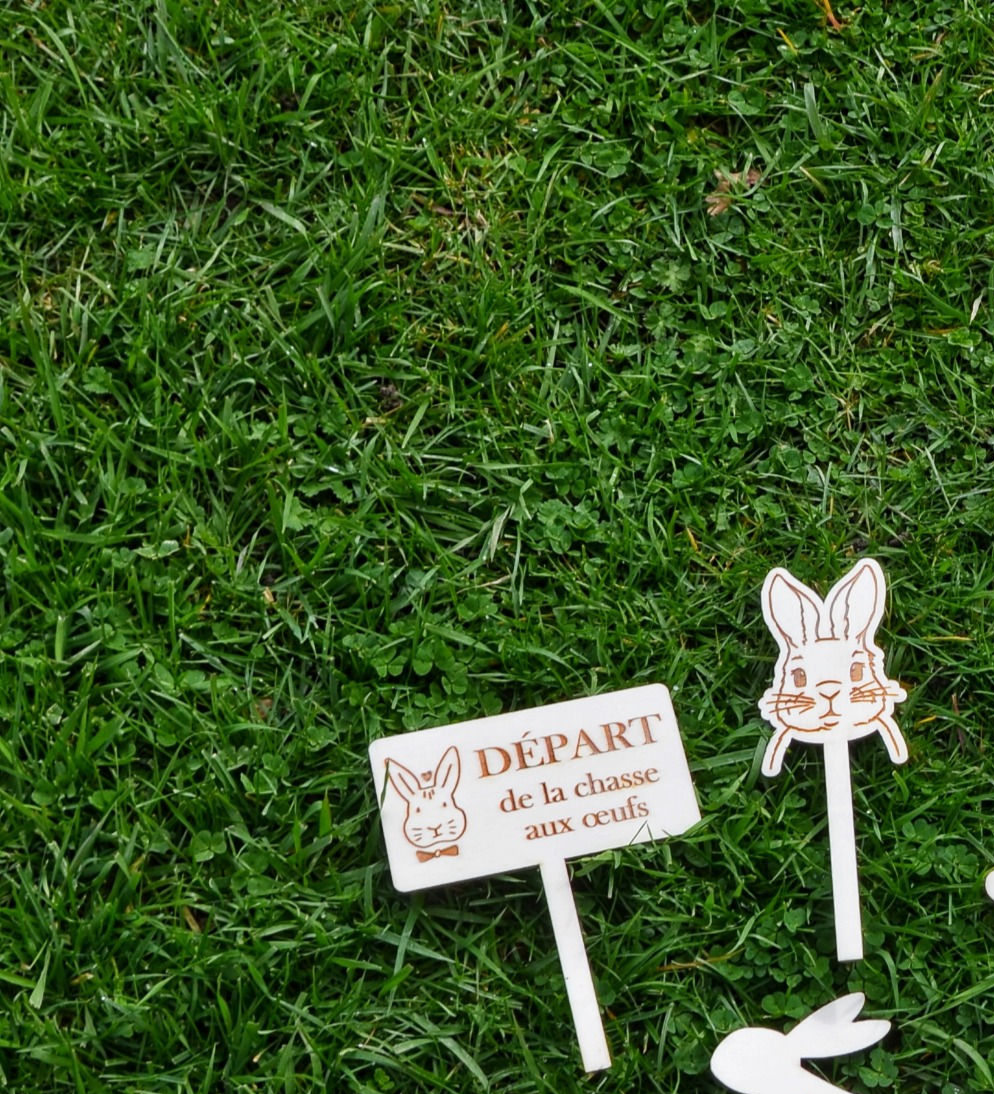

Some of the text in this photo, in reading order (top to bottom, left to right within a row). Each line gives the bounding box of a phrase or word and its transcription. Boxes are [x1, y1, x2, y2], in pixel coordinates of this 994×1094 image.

[473, 713, 662, 779] DÉPART
[499, 767, 661, 814] de la chasse
[525, 796, 650, 841] aux œufs
